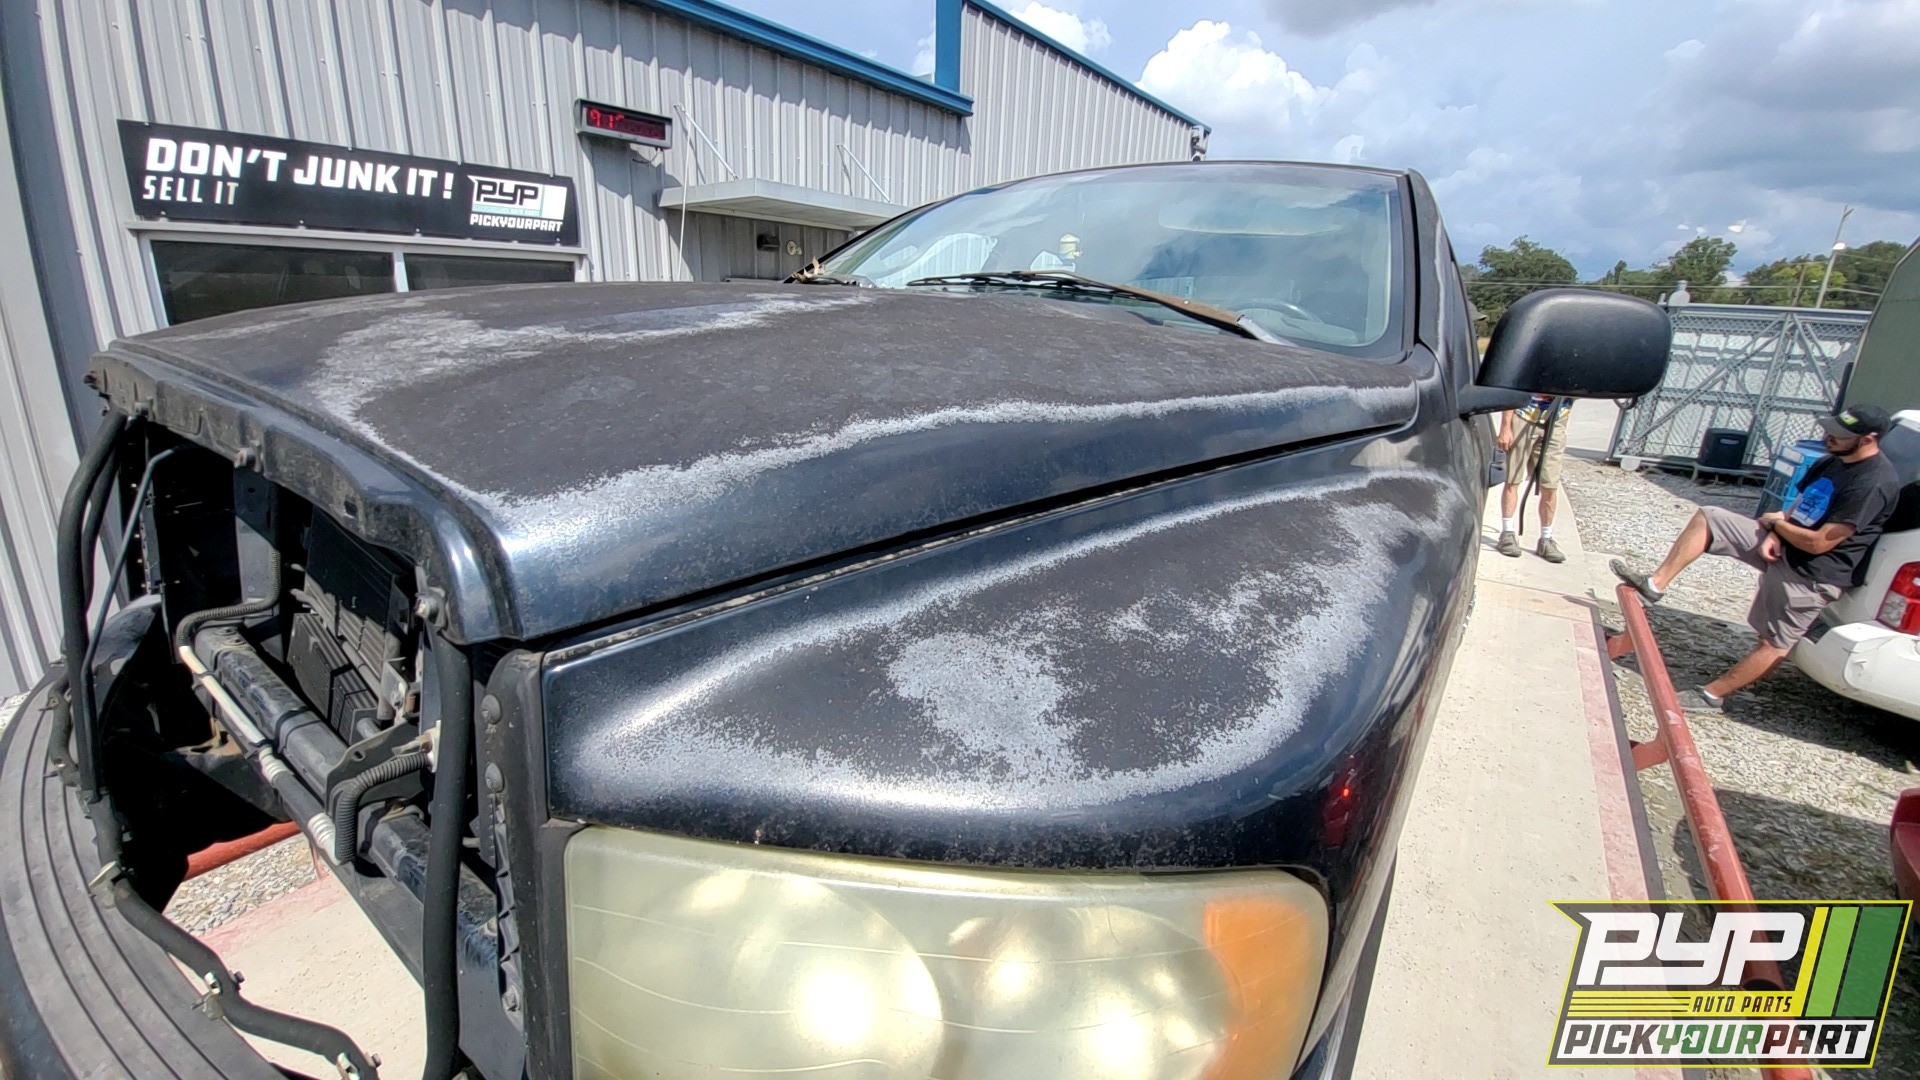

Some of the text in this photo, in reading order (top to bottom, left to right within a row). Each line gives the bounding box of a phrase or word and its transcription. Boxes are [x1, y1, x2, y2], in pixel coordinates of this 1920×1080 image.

[146, 138, 454, 199] DON'T JUNK IT!
[143, 175, 239, 205] SELL IT
[475, 179, 539, 206] PYP
[470, 213, 563, 232] PICKYOURPART
